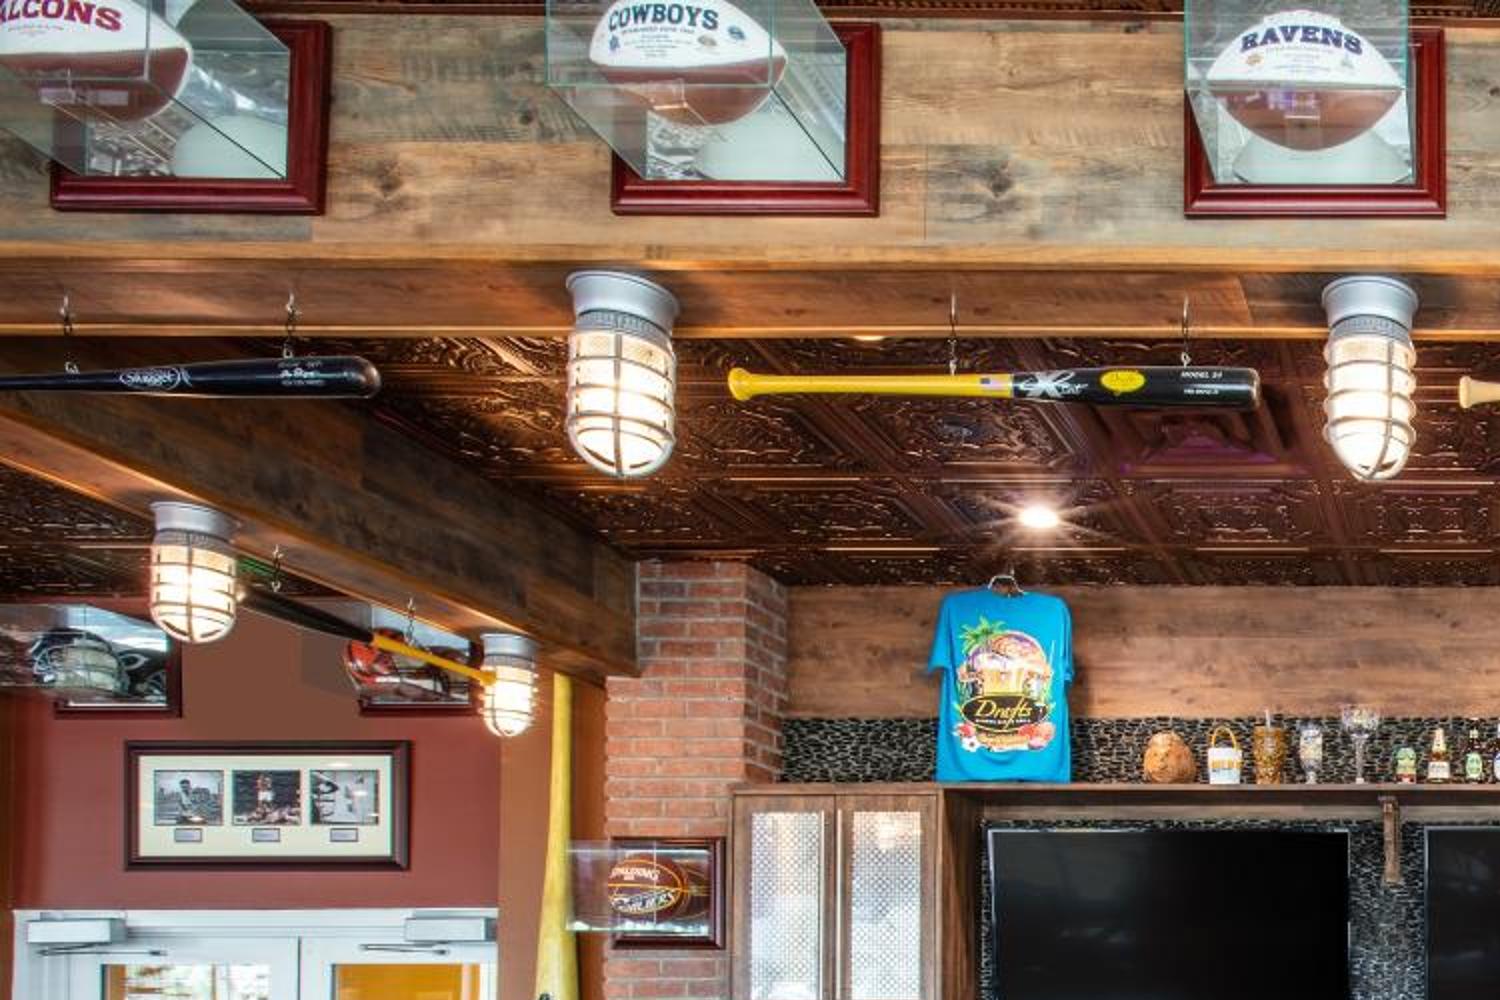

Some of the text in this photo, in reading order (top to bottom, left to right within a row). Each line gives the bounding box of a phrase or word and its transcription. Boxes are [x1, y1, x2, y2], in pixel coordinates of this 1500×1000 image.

[608, 3, 719, 31] COWBOYS
[1240, 25, 1363, 55] RAVENS
[975, 697, 1032, 731] Drafts
